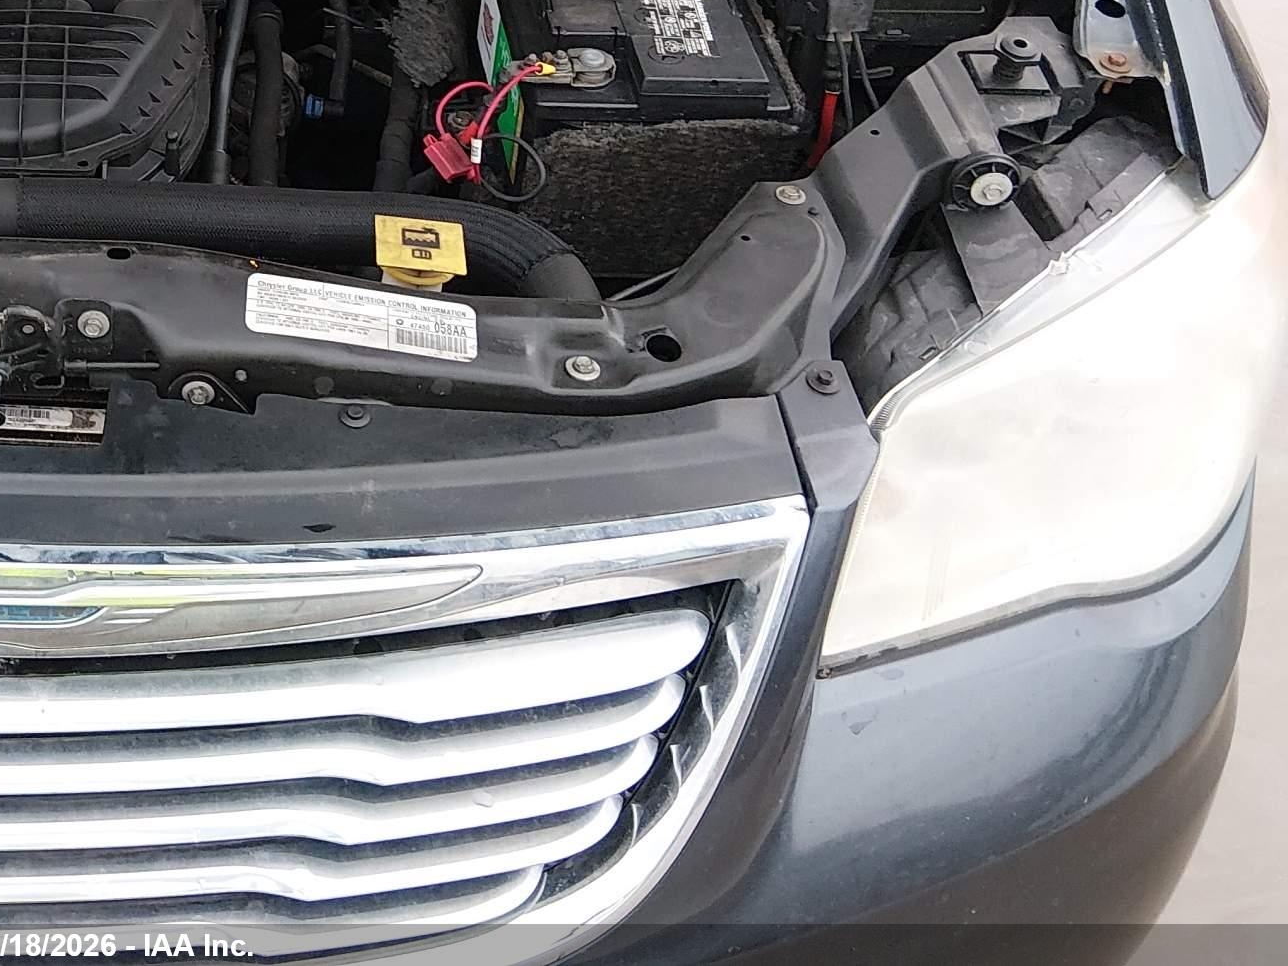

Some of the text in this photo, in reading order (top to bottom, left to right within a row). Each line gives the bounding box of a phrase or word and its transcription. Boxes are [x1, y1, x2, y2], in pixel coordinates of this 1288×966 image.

[257, 280, 286, 290] Chrysler
[287, 285, 308, 294] Group
[324, 290, 352, 300] VEHICLE
[354, 295, 386, 305] EMISSION
[388, 300, 418, 311] CONTROL
[420, 305, 467, 317] INFORMATION
